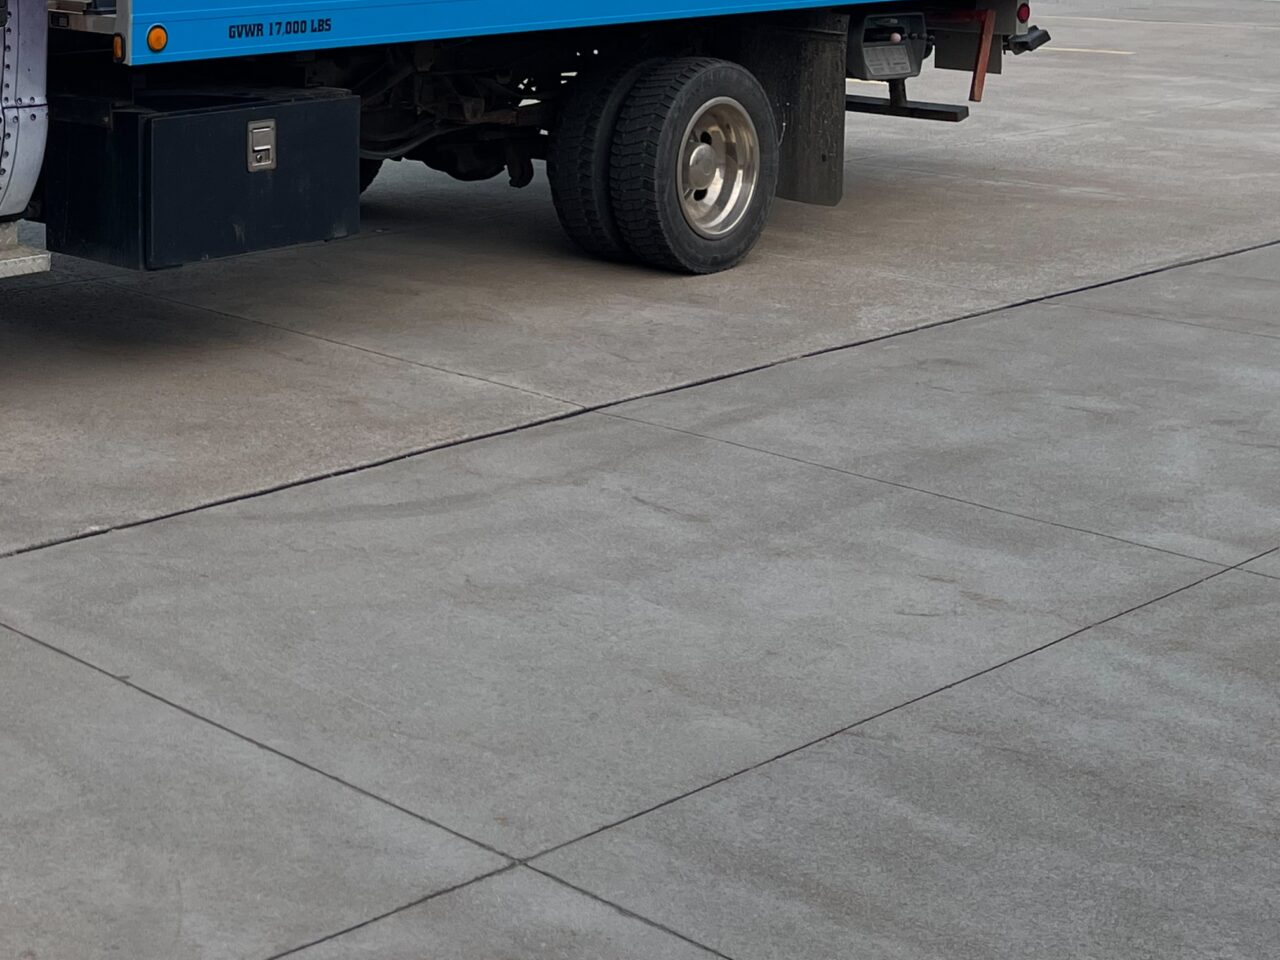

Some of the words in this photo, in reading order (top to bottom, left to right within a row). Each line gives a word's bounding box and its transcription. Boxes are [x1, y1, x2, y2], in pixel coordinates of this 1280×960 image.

[228, 24, 264, 39] GVWR
[269, 21, 307, 36] 17,000
[310, 18, 332, 33] LBS
